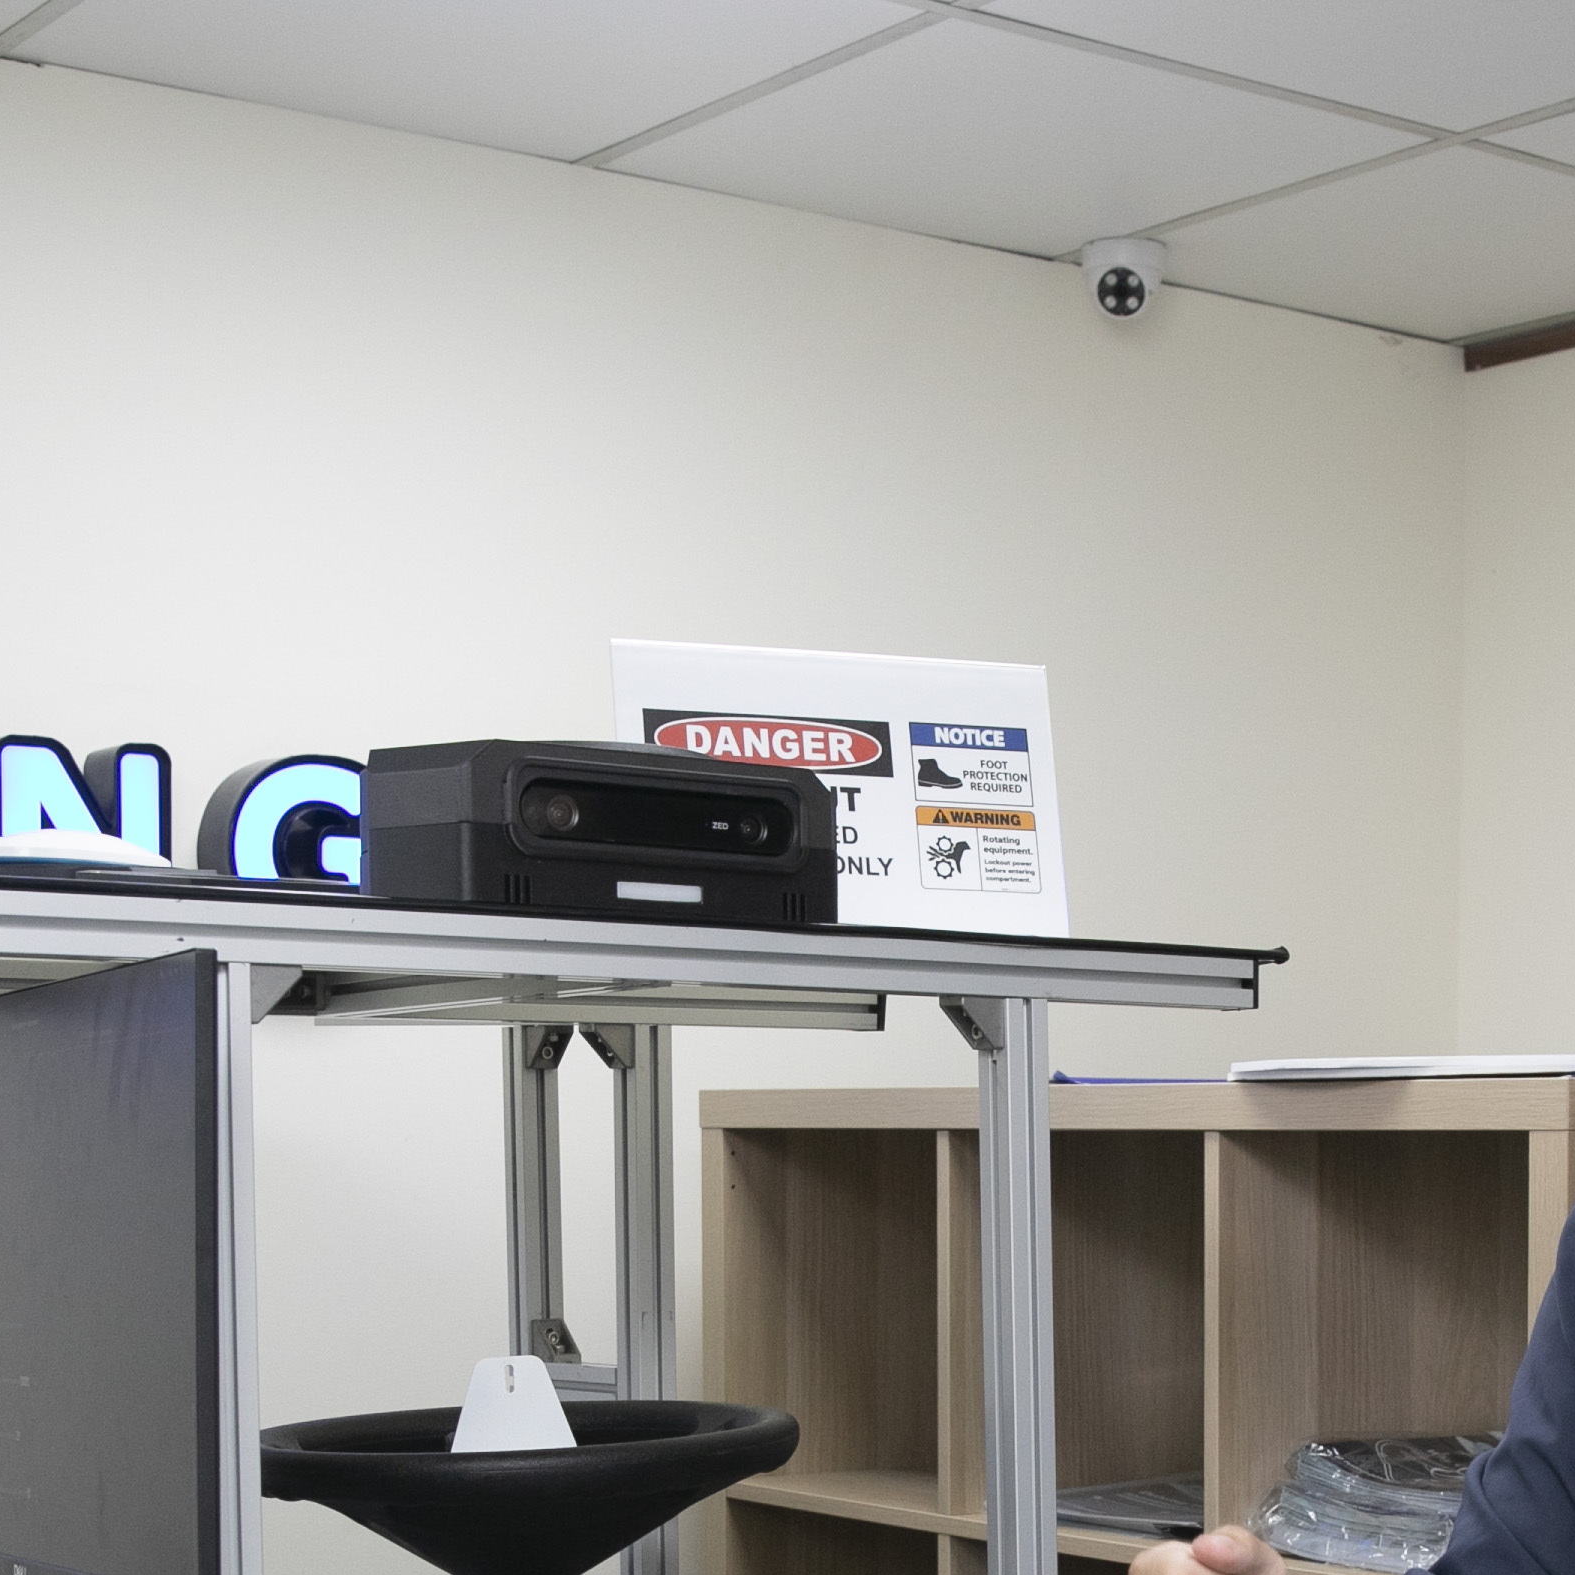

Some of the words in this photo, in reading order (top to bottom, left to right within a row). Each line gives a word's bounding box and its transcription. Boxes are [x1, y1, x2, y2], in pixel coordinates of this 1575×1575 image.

[934, 727, 1006, 748] NOTICE
[686, 724, 856, 763] DANGER
[980, 760, 1008, 770] FOOT
[962, 770, 1028, 783] PROTECTION
[970, 782, 1023, 793] REQUIRED
[950, 811, 1021, 827] WARNING
[712, 821, 729, 830] ZED
[983, 835, 1021, 846] Rotating
[983, 846, 1034, 856] equipment.
